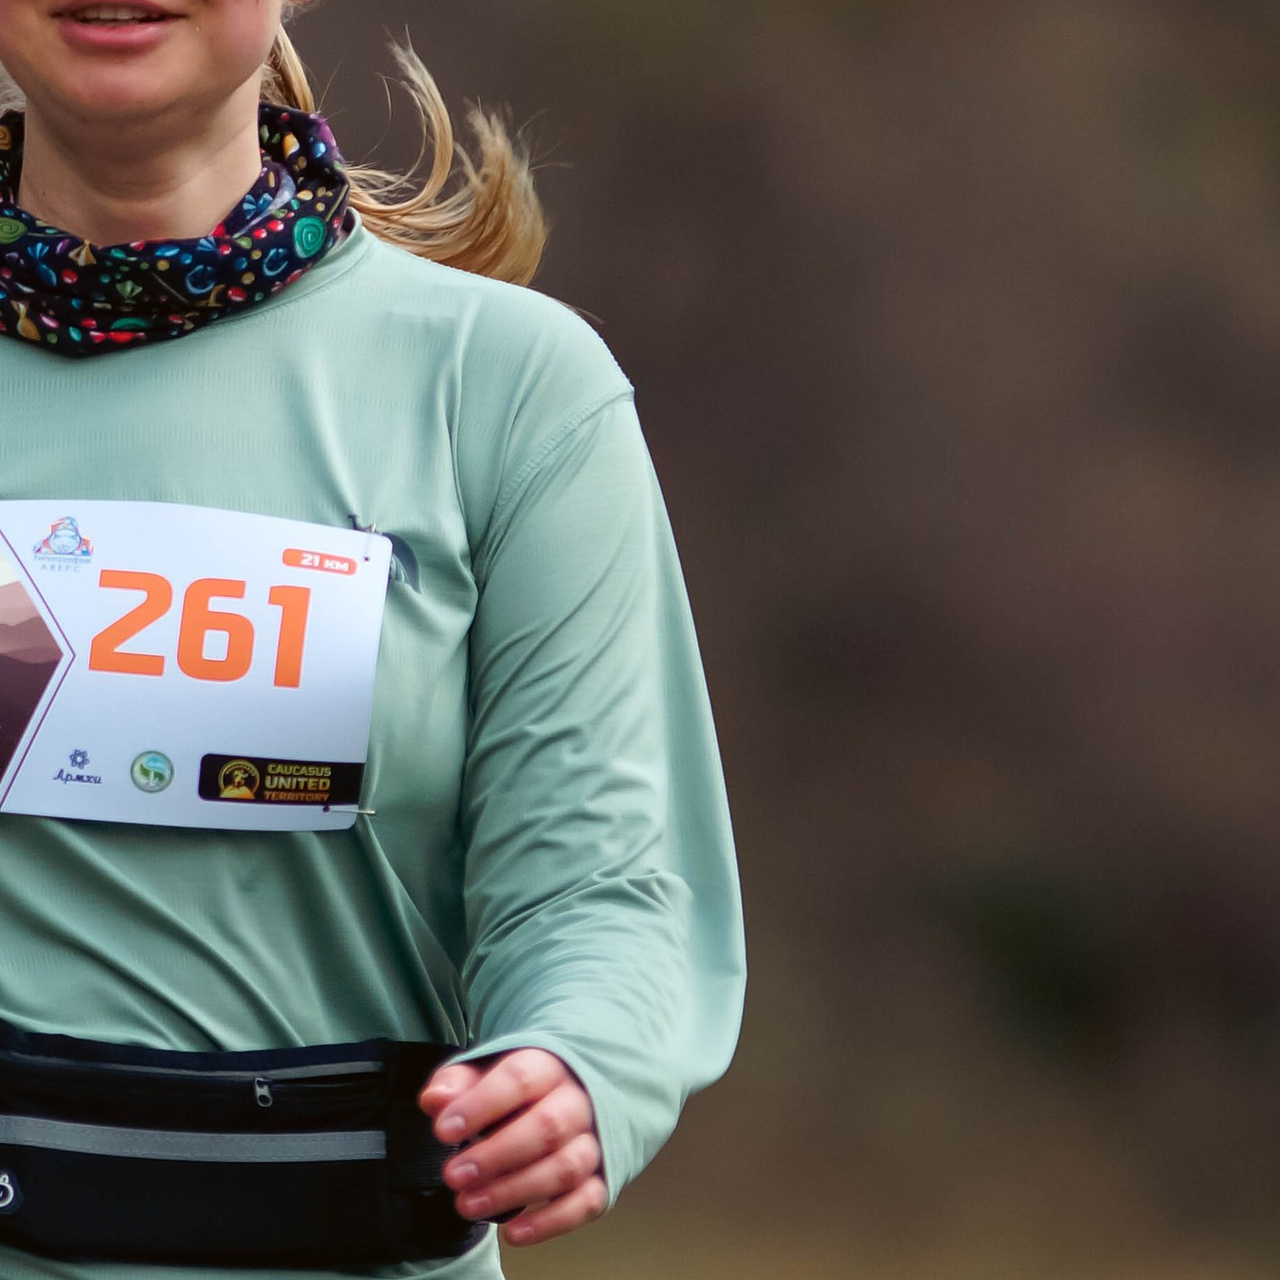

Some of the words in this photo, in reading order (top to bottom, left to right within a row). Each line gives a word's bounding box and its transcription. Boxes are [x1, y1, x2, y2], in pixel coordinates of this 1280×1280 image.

[301, 553, 320, 567] 21
[88, 569, 311, 688] 261
[53, 769, 102, 784] Армхи
[268, 764, 331, 777] CAUCASUS
[265, 777, 330, 790] UNITED
[265, 791, 329, 801] TERRITORY
